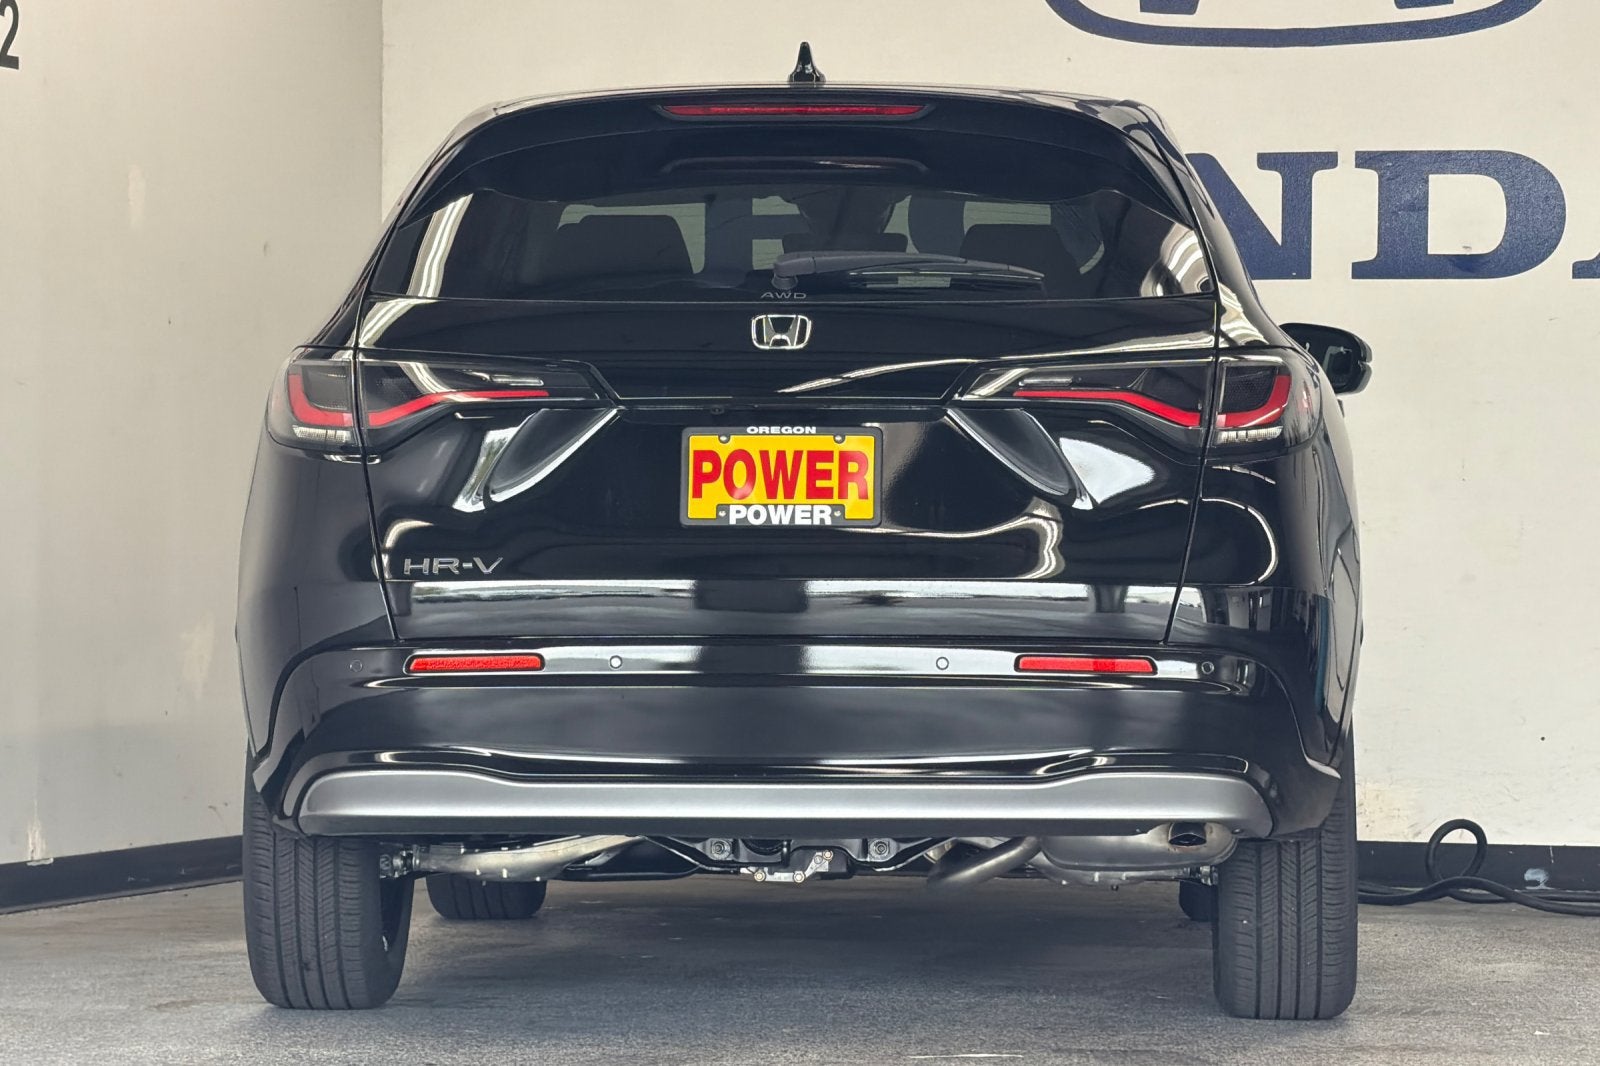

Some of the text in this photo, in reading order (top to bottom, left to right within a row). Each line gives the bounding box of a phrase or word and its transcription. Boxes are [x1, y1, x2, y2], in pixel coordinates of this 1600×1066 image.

[0, 0, 19, 70] 2
[1185, 150, 1600, 280] ND
[761, 291, 807, 299] AWD
[746, 426, 817, 434] OREGON
[692, 449, 869, 500] POWER
[729, 504, 832, 525] POWER
[403, 557, 504, 575] HR-V
